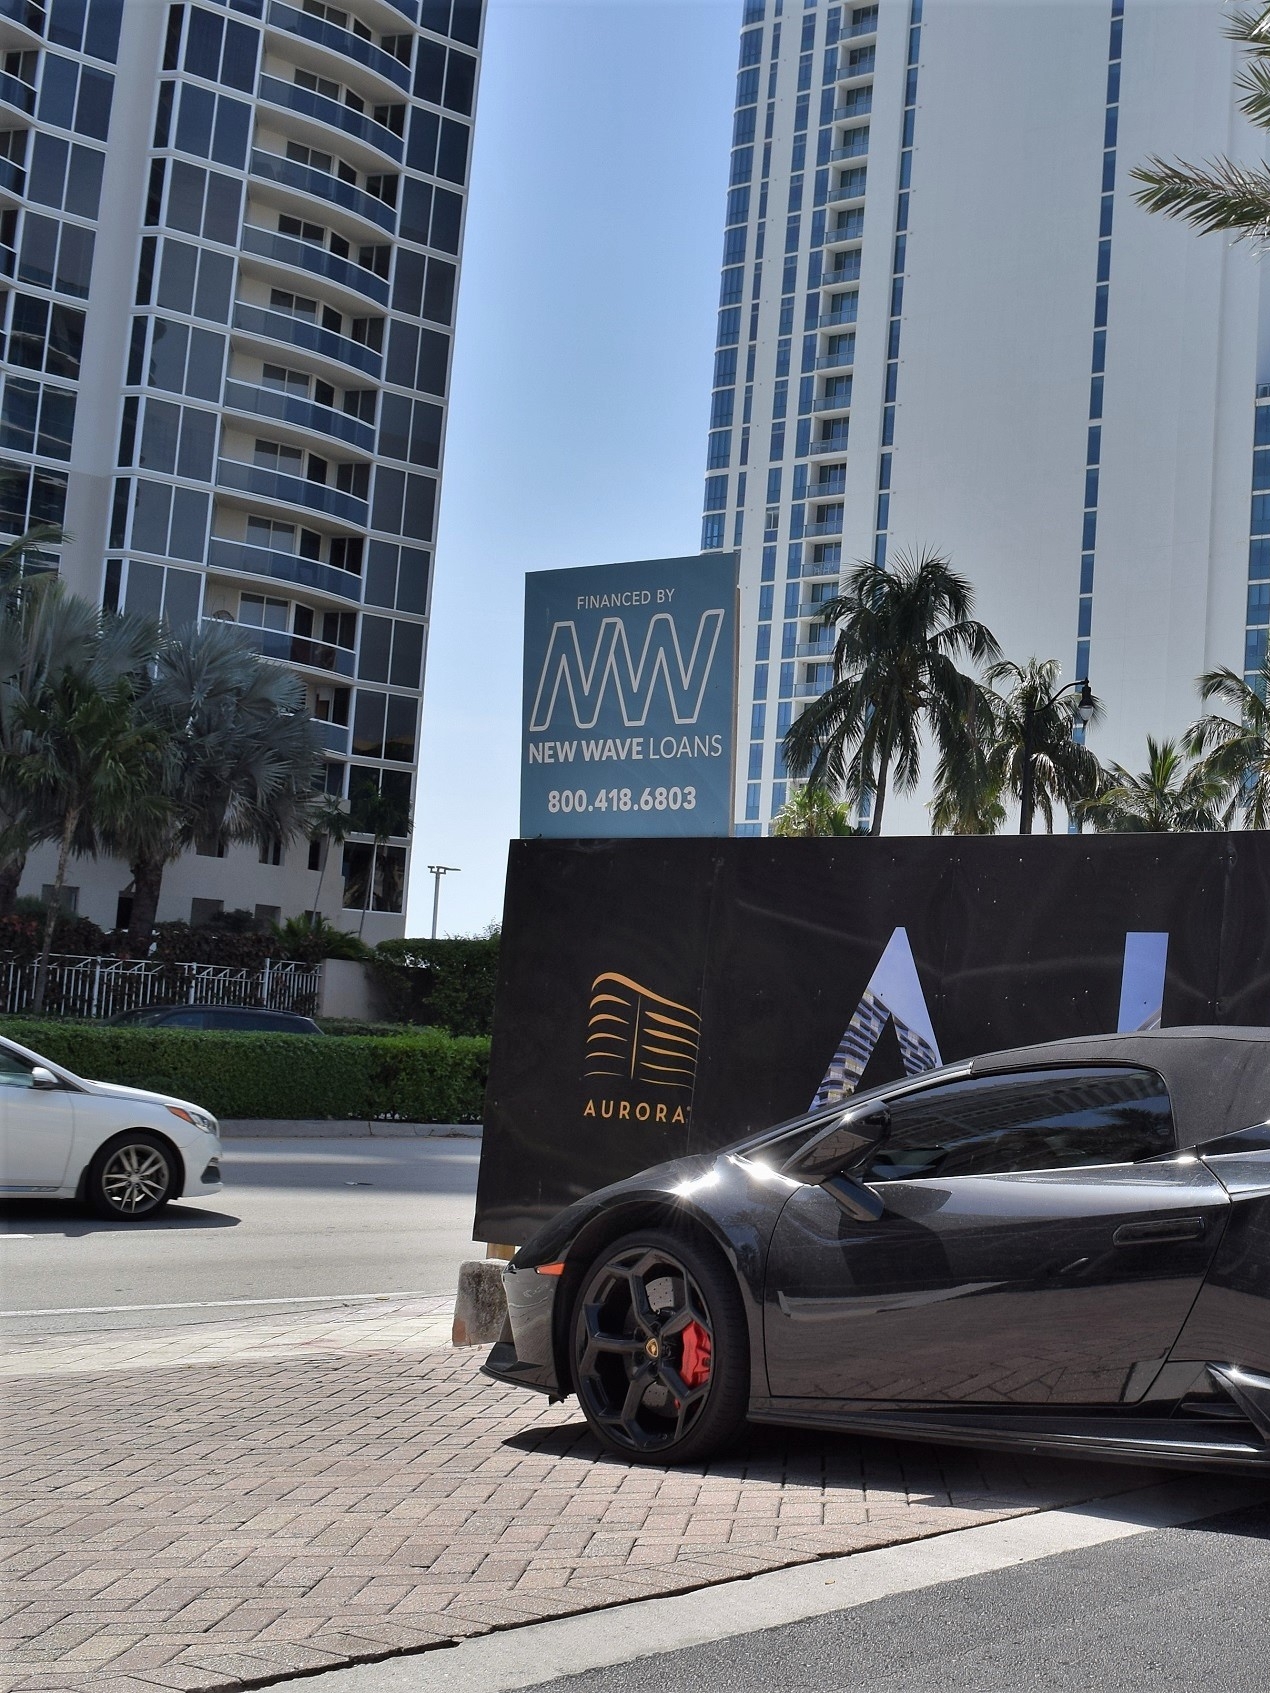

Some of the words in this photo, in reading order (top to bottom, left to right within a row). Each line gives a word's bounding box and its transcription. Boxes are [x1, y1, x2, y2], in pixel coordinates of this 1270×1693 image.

[577, 590, 651, 610] FINANCED
[657, 588, 676, 603] BY
[529, 740, 577, 764] NEW
[581, 737, 644, 762] WAVE
[650, 734, 723, 759] LOANS
[548, 786, 697, 813] 800.418.6803
[583, 1099, 685, 1124] AURORA
